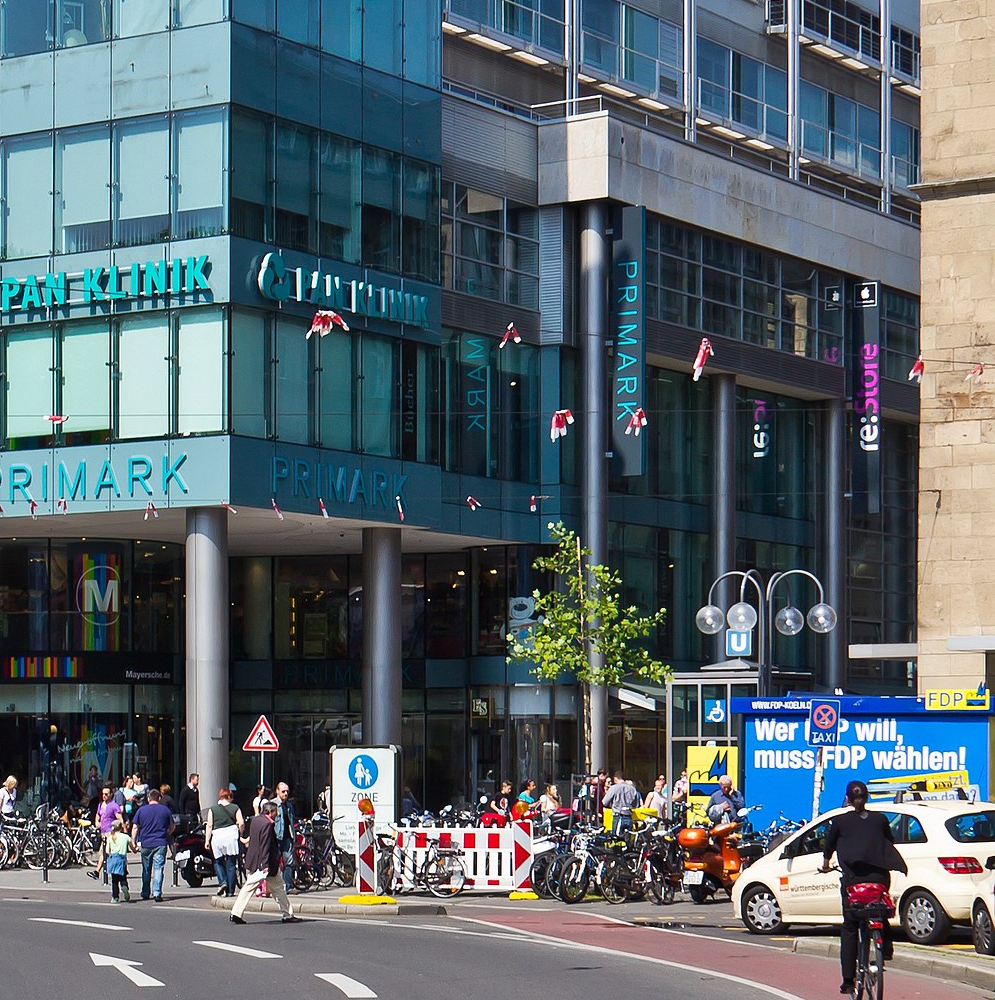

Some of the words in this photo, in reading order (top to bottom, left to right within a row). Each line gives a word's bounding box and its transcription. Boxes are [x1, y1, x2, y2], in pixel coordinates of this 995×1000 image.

[2, 271, 66, 312] PAN
[84, 255, 209, 301] KLINIK
[295, 267, 343, 309] PAN
[351, 279, 429, 328] KLINIK
[617, 261, 638, 421] PRIMARK
[271, 456, 409, 510] PRIMARK
[84, 580, 119, 612] M
[730, 633, 747, 652] U
[125, 670, 171, 680] Mayersche.de
[928, 692, 964, 707] FDP
[754, 718, 798, 742] Wer
[854, 717, 904, 744] will,
[811, 732, 835, 743] TAXI
[754, 749, 815, 769] muss
[822, 746, 867, 770] FDP
[872, 745, 967, 771] wählen!
[351, 792, 379, 802] ZONE
